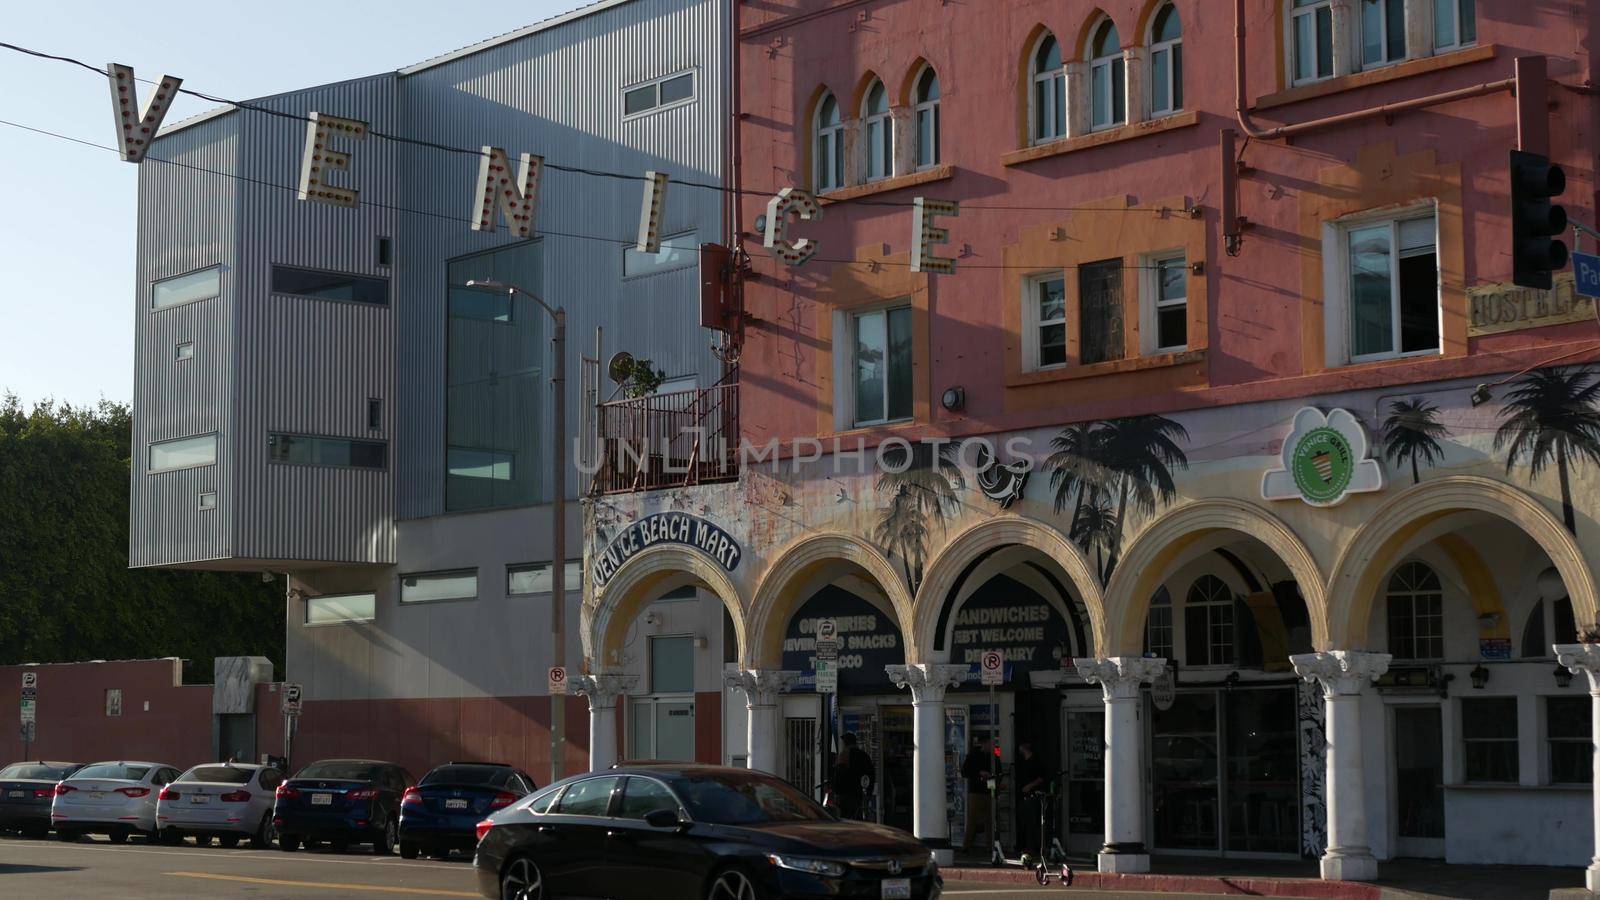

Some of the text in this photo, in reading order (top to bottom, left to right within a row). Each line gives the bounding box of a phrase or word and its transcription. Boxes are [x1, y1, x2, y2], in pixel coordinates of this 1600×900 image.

[107, 63, 959, 275] VENICE
[1580, 262, 1600, 286] Pa
[1298, 434, 1348, 465] VENICE GRILL
[593, 515, 739, 587] VENICE BEACH MART
[799, 614, 877, 633] GRERIES
[784, 635, 845, 652] EVERS
[848, 633, 897, 649] SNACKS
[980, 626, 1044, 643] WELCOME
[808, 654, 864, 669] TCCO
[964, 645, 1037, 663] DE AIRY
